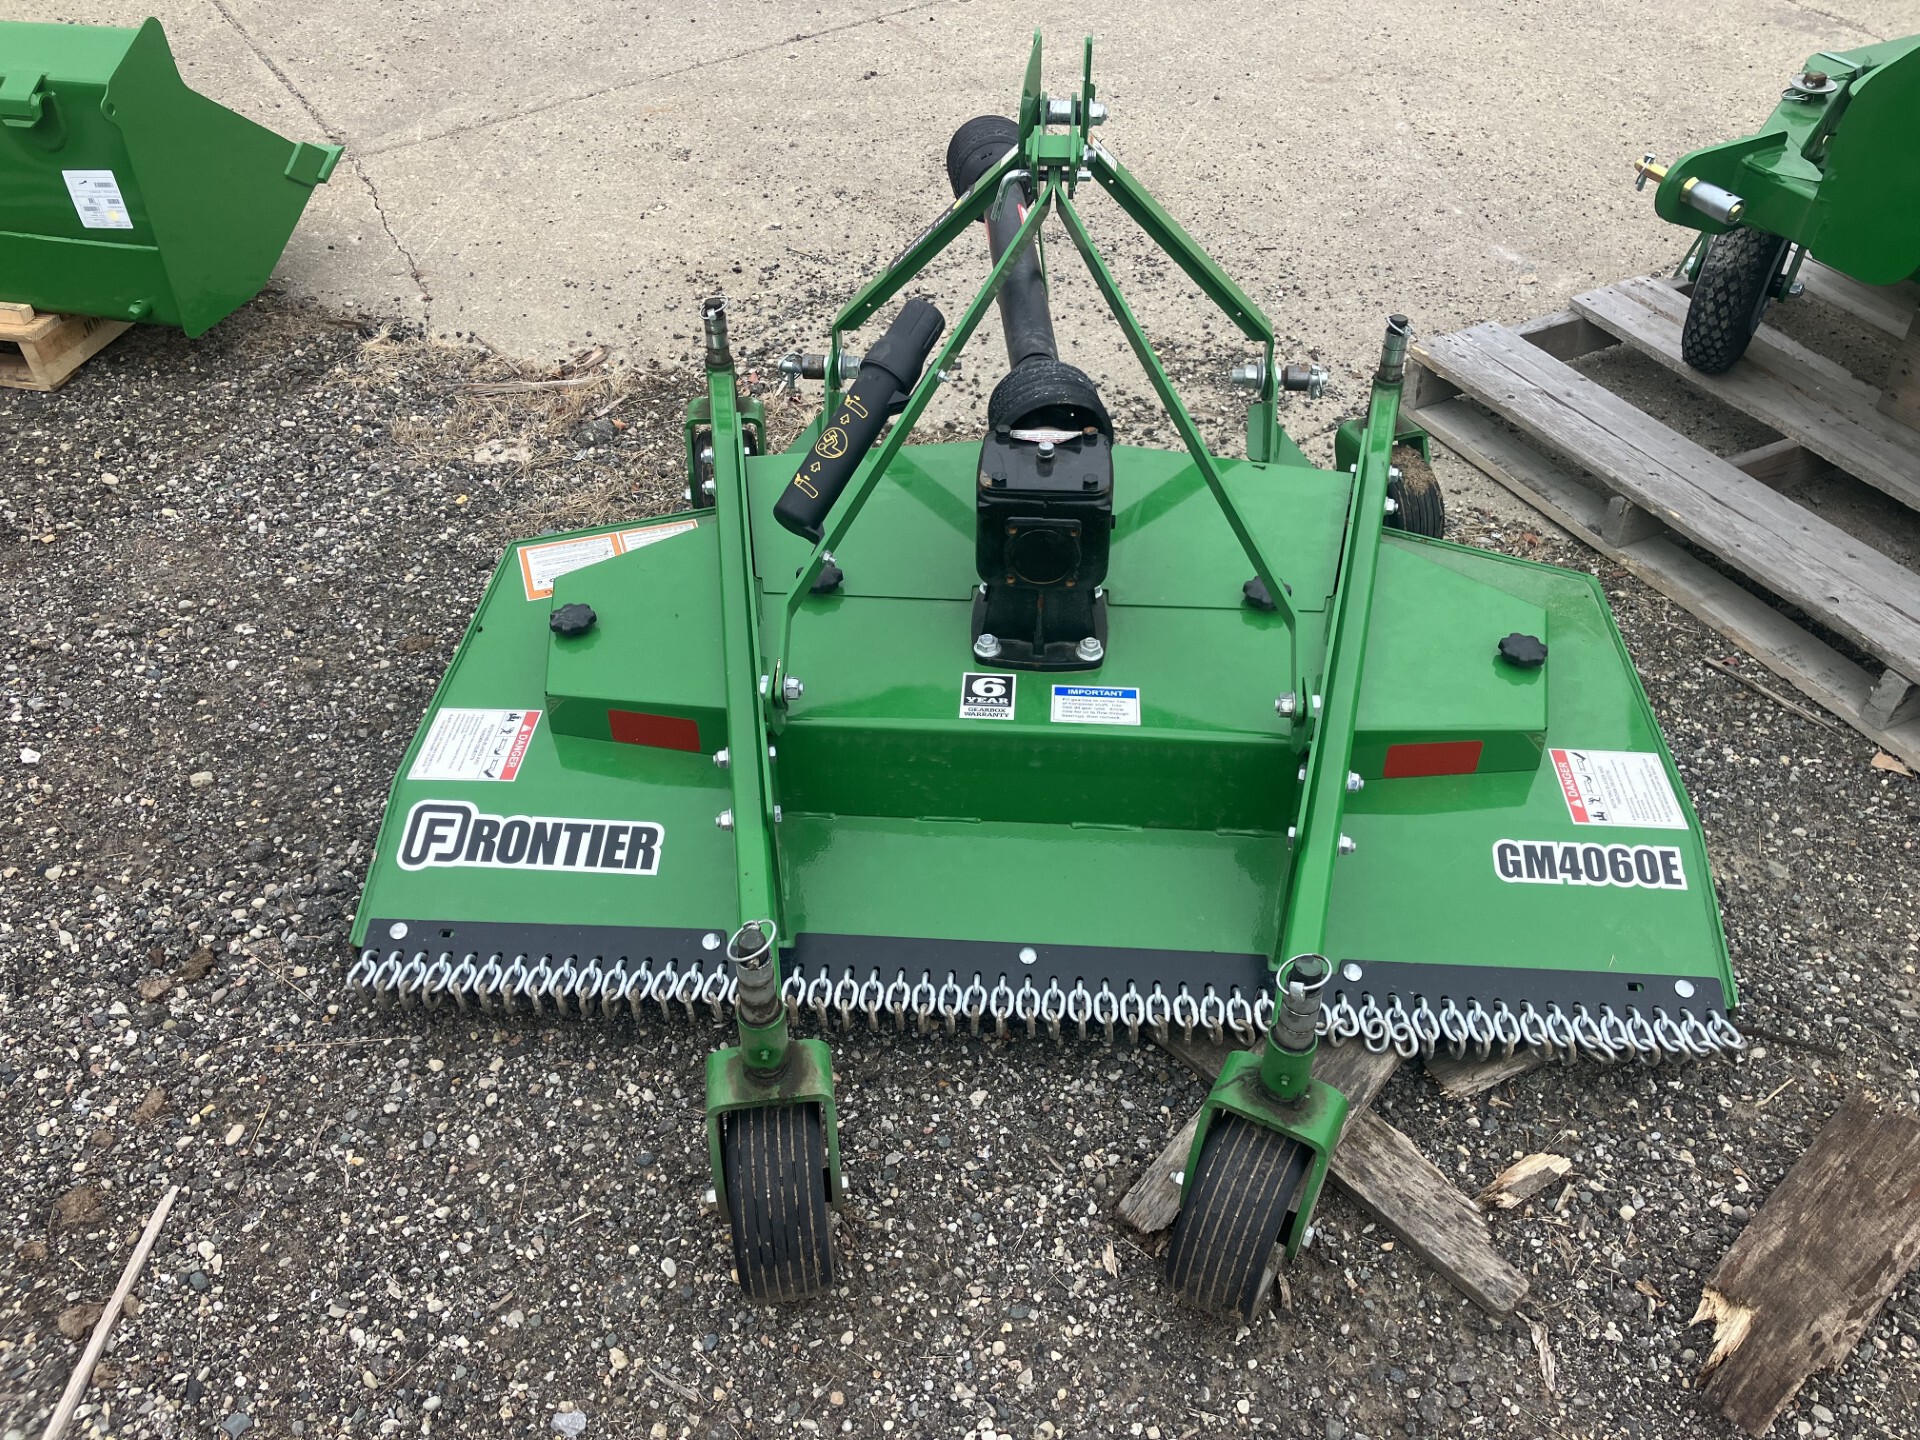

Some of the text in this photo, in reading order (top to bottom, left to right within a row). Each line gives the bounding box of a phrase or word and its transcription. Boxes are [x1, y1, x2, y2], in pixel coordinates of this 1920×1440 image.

[965, 696, 1009, 704] YEAR
[972, 677, 1006, 697] 6
[1067, 689, 1124, 697] IMPORTANT
[507, 734, 529, 768] DANGER
[1558, 761, 1579, 797] DANGER
[402, 804, 659, 870] FRONTIER
[1497, 843, 1682, 886] GM4060E
